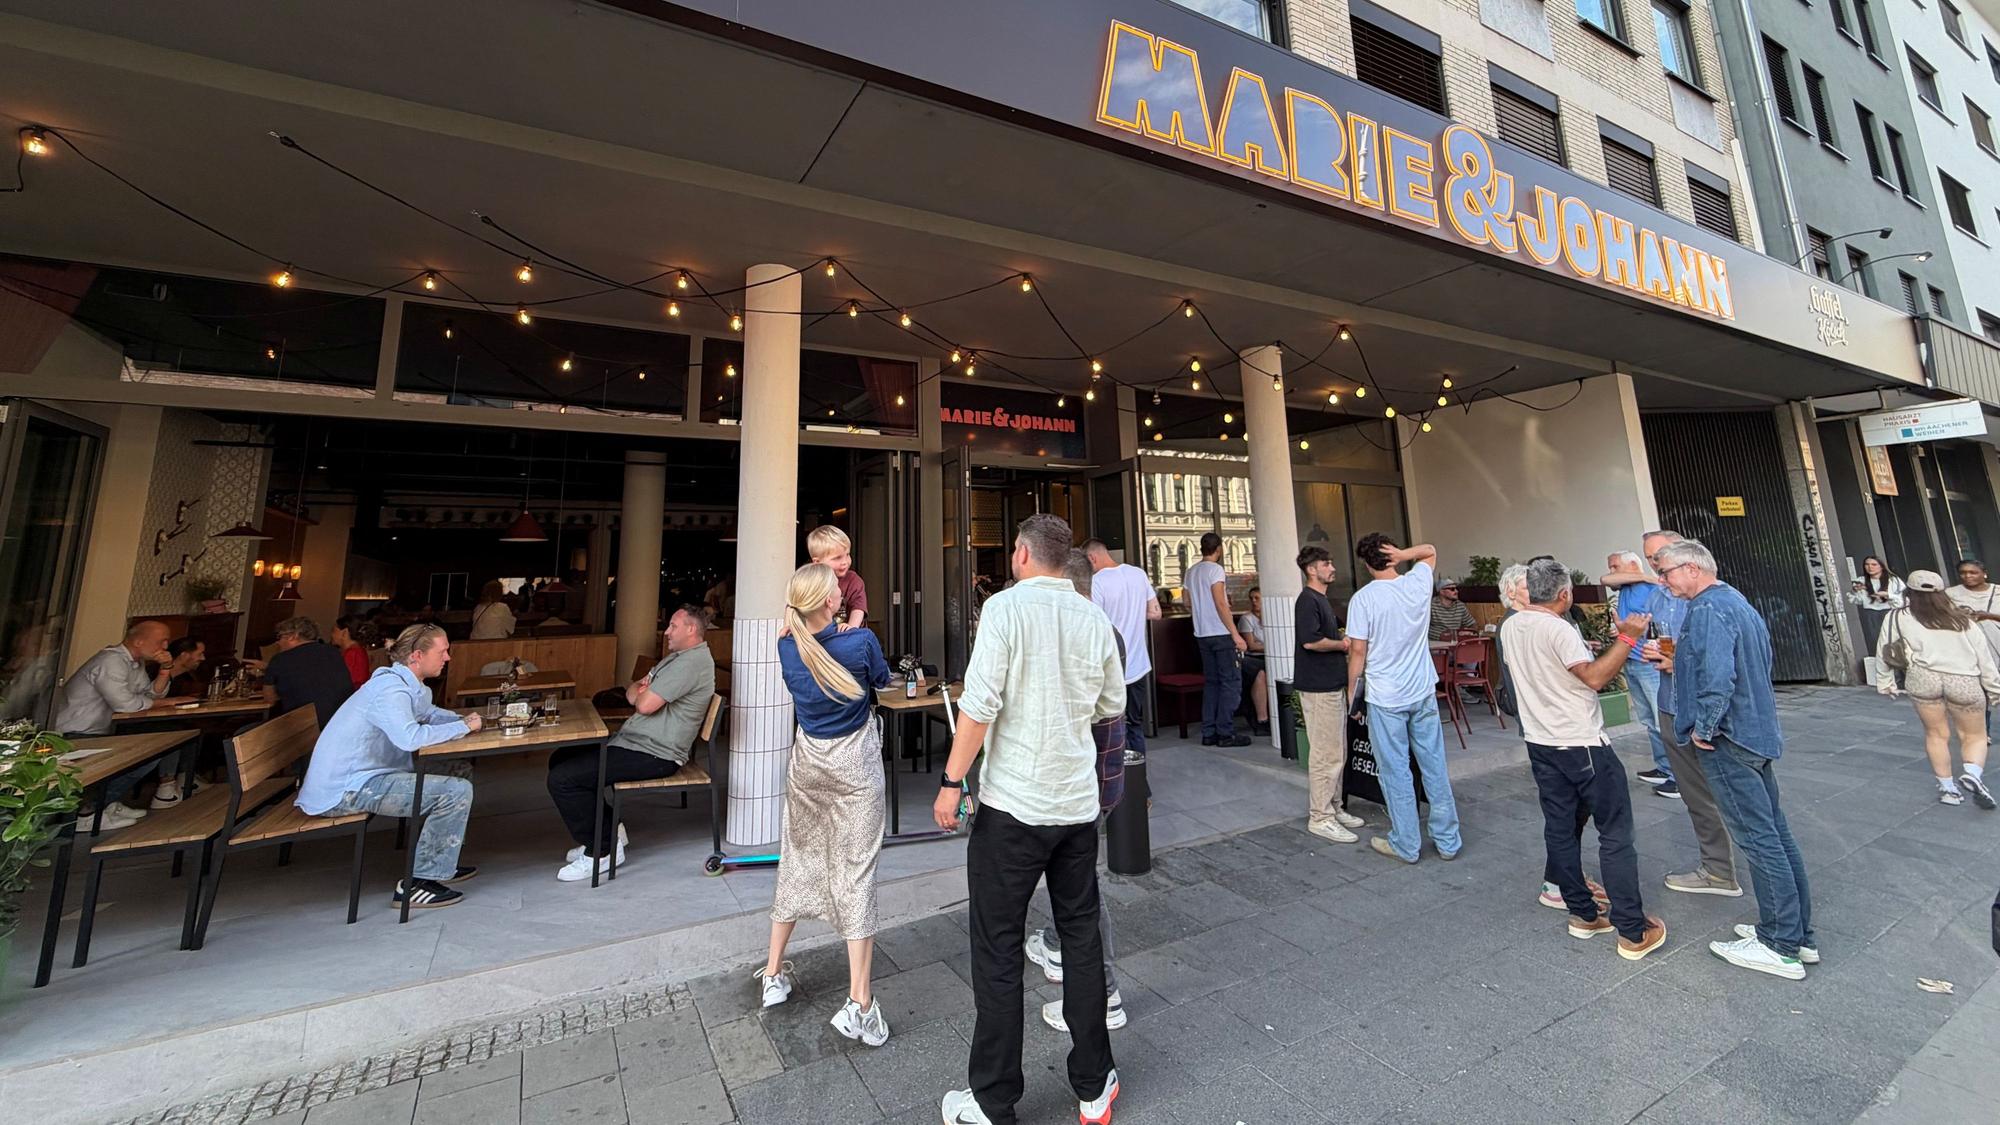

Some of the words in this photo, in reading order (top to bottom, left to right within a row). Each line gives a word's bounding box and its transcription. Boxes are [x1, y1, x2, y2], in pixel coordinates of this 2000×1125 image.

[1809, 284, 1846, 320] Gaffel
[1883, 412, 1921, 422] HAUSARZT
[1927, 421, 1968, 430] AACHENER
